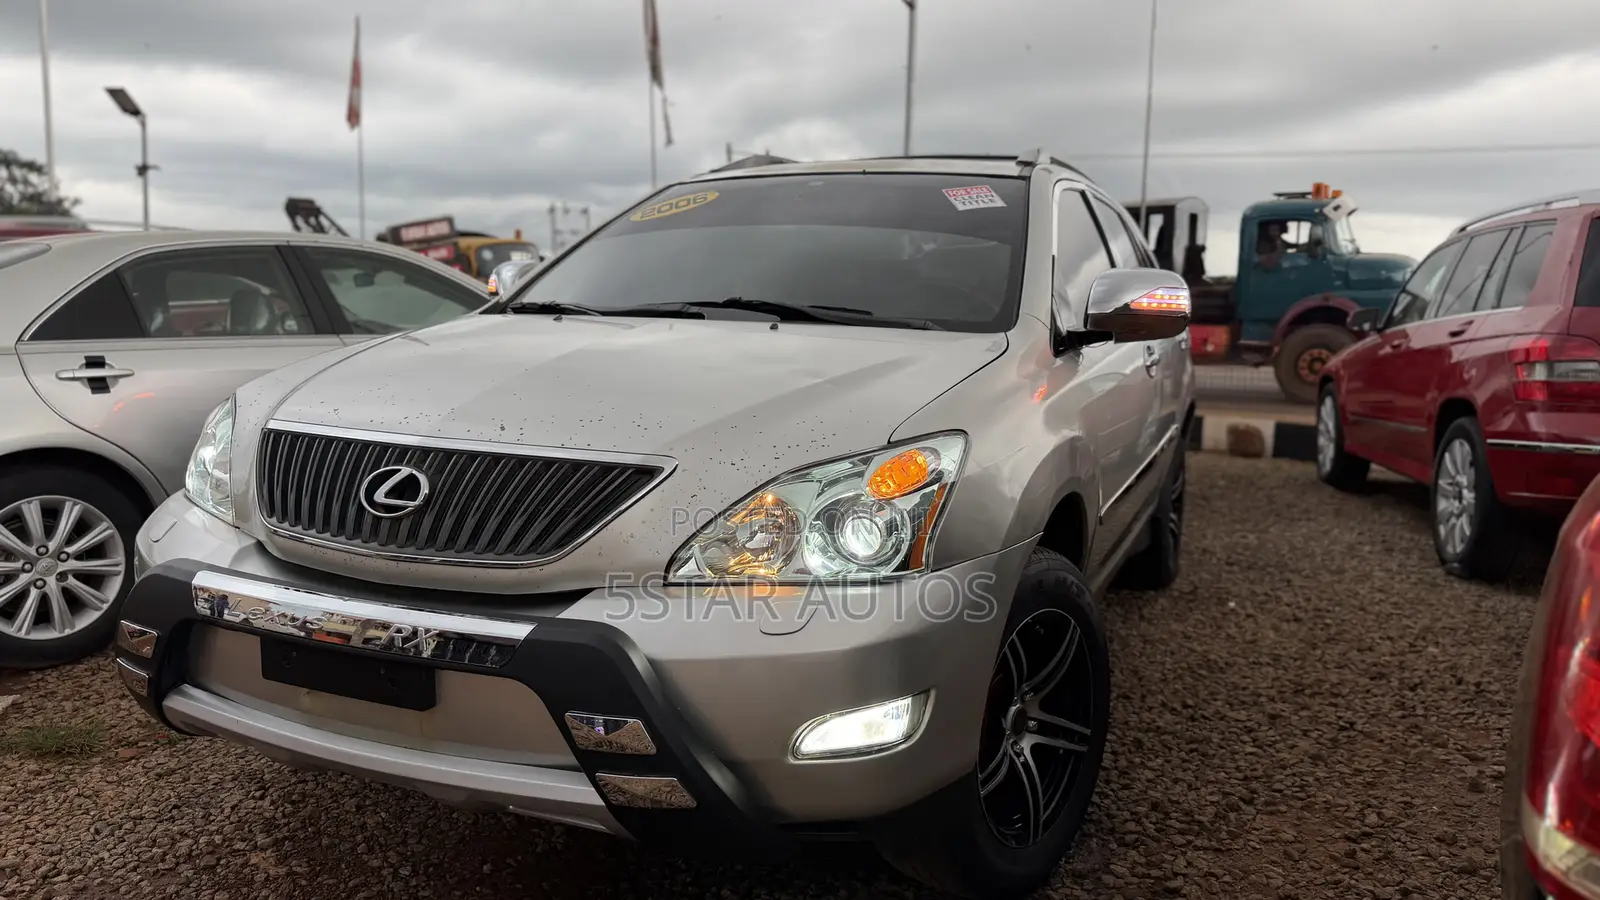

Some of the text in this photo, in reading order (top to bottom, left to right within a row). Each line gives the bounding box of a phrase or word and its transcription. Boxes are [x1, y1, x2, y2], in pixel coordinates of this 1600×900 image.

[947, 186, 990, 197] FOR SALE
[953, 193, 995, 202] CLEAN
[961, 198, 994, 206] TITLE
[640, 192, 709, 219] 2006
[227, 599, 441, 651] Lexus RX
